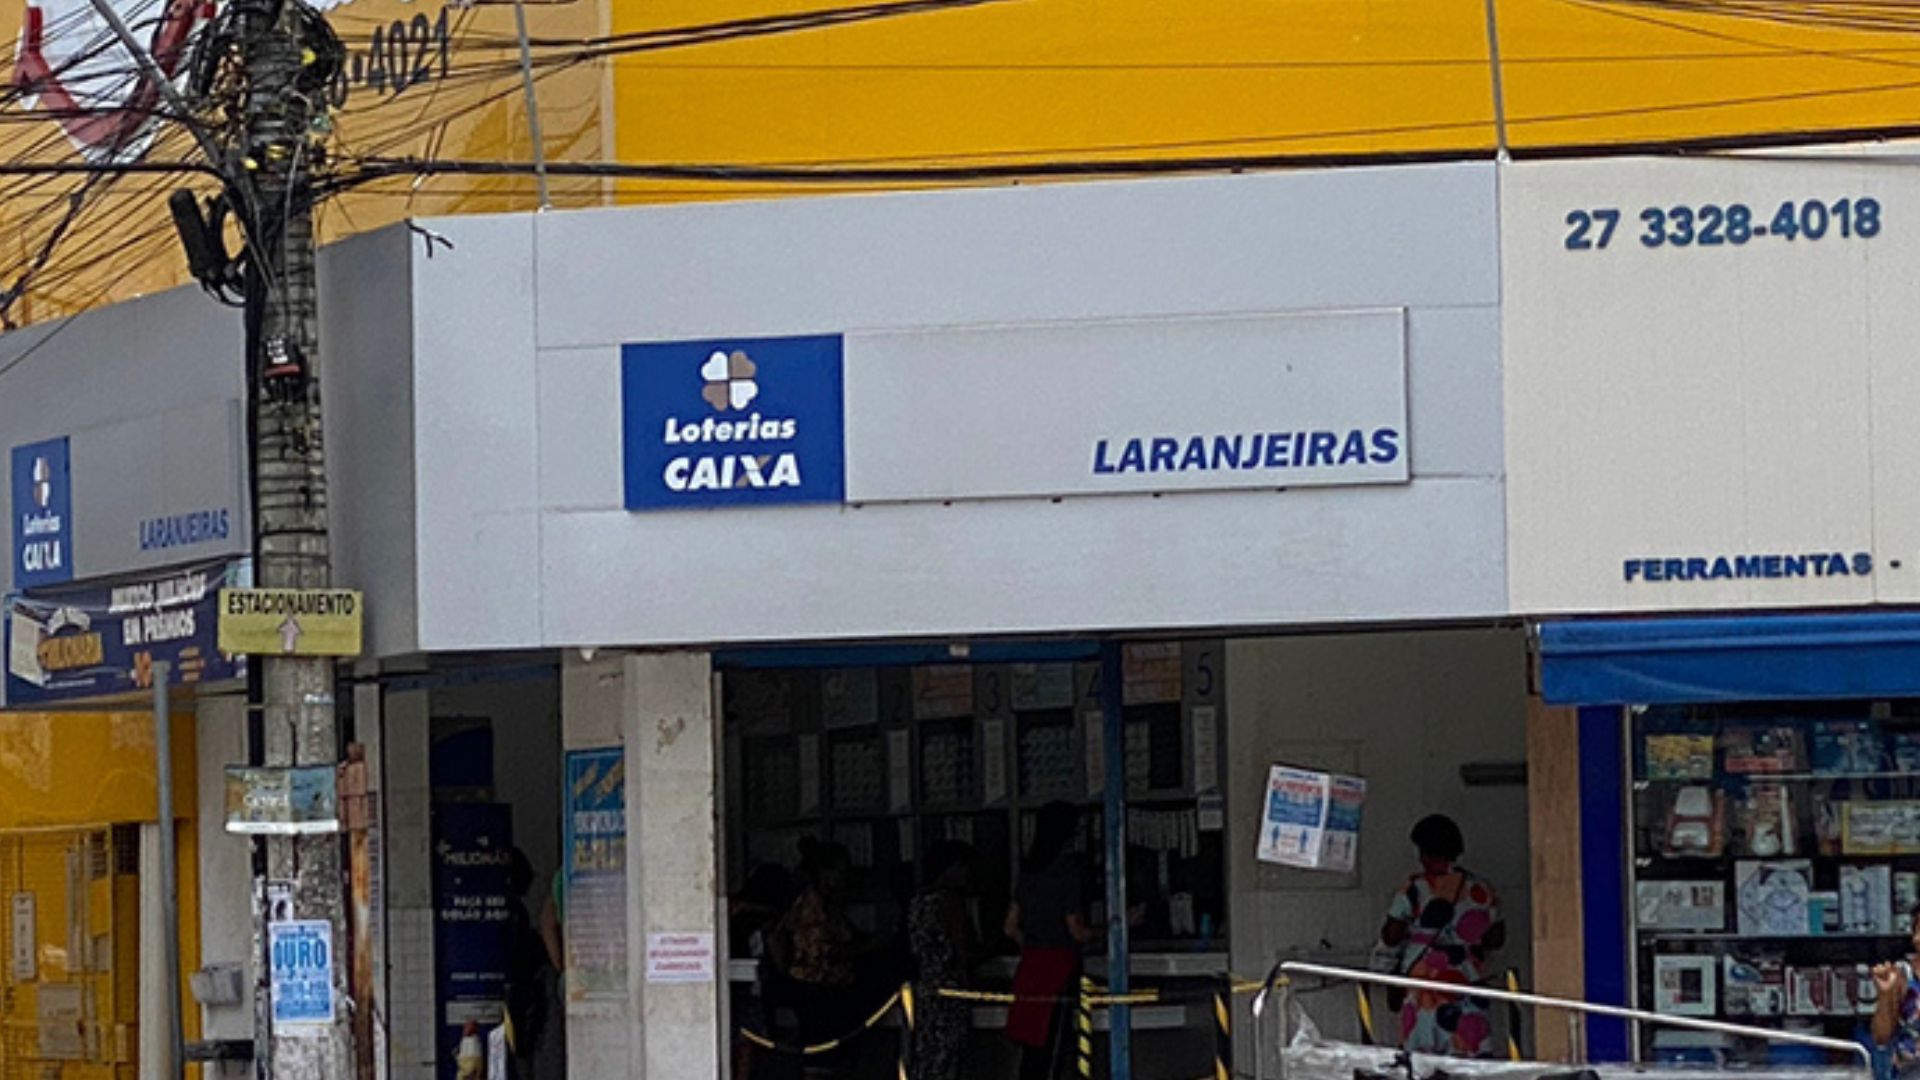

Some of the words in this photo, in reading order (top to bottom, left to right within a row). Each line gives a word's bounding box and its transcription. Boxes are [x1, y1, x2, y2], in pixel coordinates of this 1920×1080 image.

[1564, 209, 1621, 250] 27
[1639, 198, 1881, 247] 3328-4018
[664, 412, 797, 443] Loterias
[1093, 428, 1399, 474] LARANJEIRAS
[664, 453, 801, 491] CAIXA
[1623, 553, 1873, 582] FERRAMENTAS
[228, 593, 356, 615] ESTACIONAMENTO
[1194, 652, 1214, 697] 5
